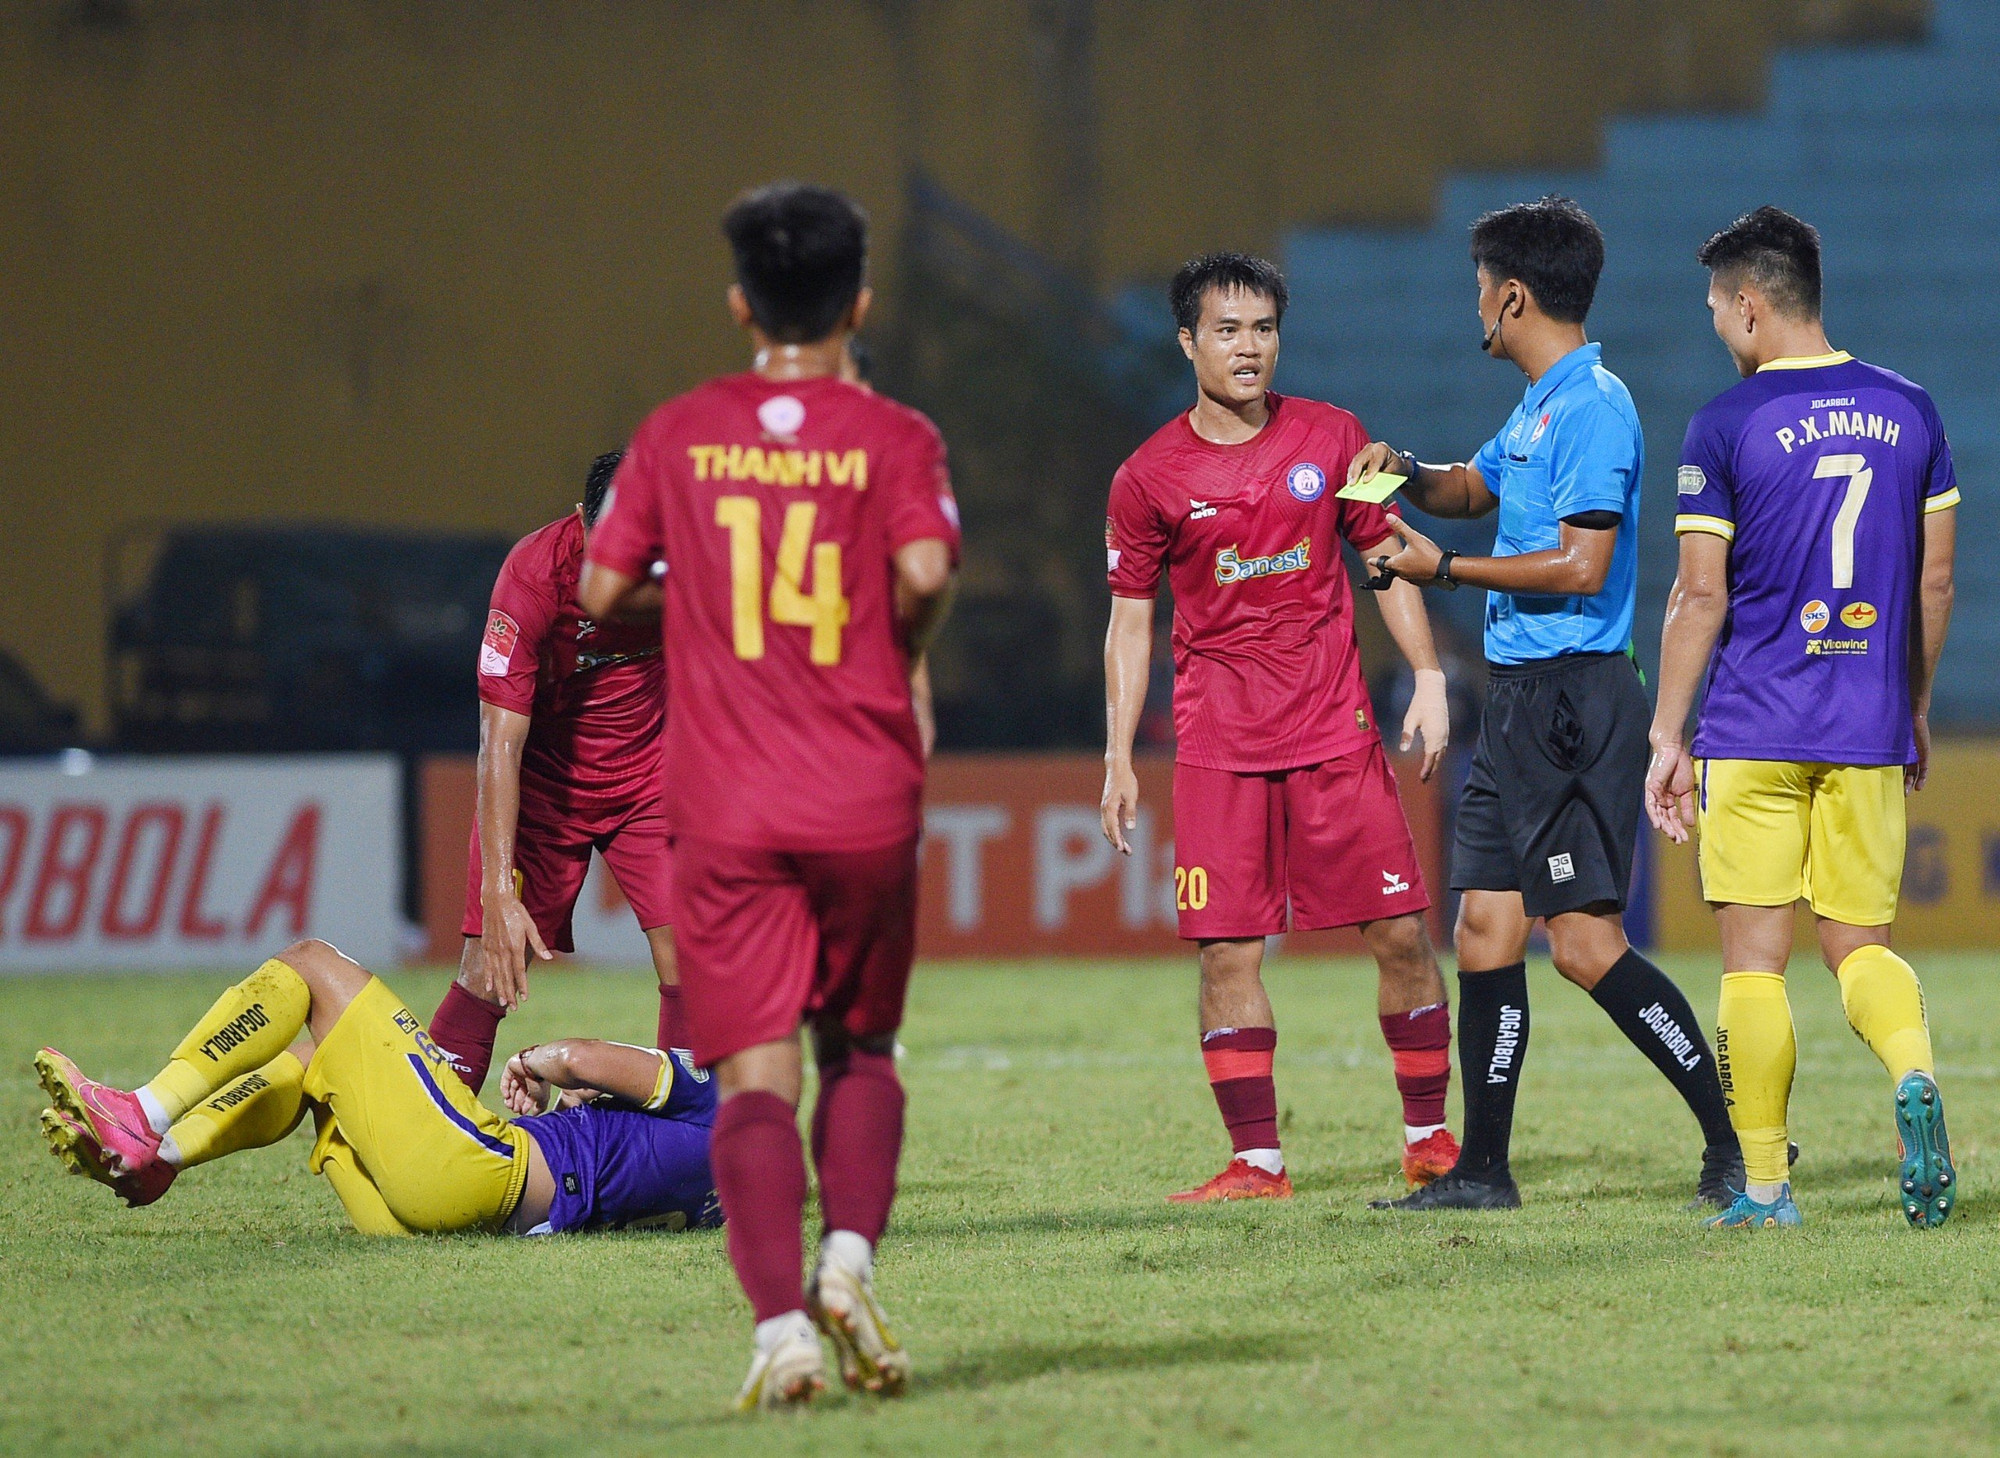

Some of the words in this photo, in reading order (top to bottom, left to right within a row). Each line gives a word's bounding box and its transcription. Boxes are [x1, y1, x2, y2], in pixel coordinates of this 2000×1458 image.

[1810, 397, 1856, 409] JOGARBOLA
[1775, 411, 1901, 454] P.X.MẠNH
[687, 444, 823, 487] THANH
[1812, 453, 1873, 588] 7
[715, 495, 850, 666] 14
[1215, 543, 1310, 586] Sanest
[1804, 612, 1827, 621] SHS
[1175, 866, 1208, 910] 20
[199, 1003, 271, 1062] JOGARBOLA
[1487, 1005, 1522, 1084] JOGARBOLA
[1638, 1002, 1702, 1072] JOGARBOLA
[1716, 1026, 1736, 1108] JOGARBOLA
[207, 1073, 270, 1112] JOGARBOLA
